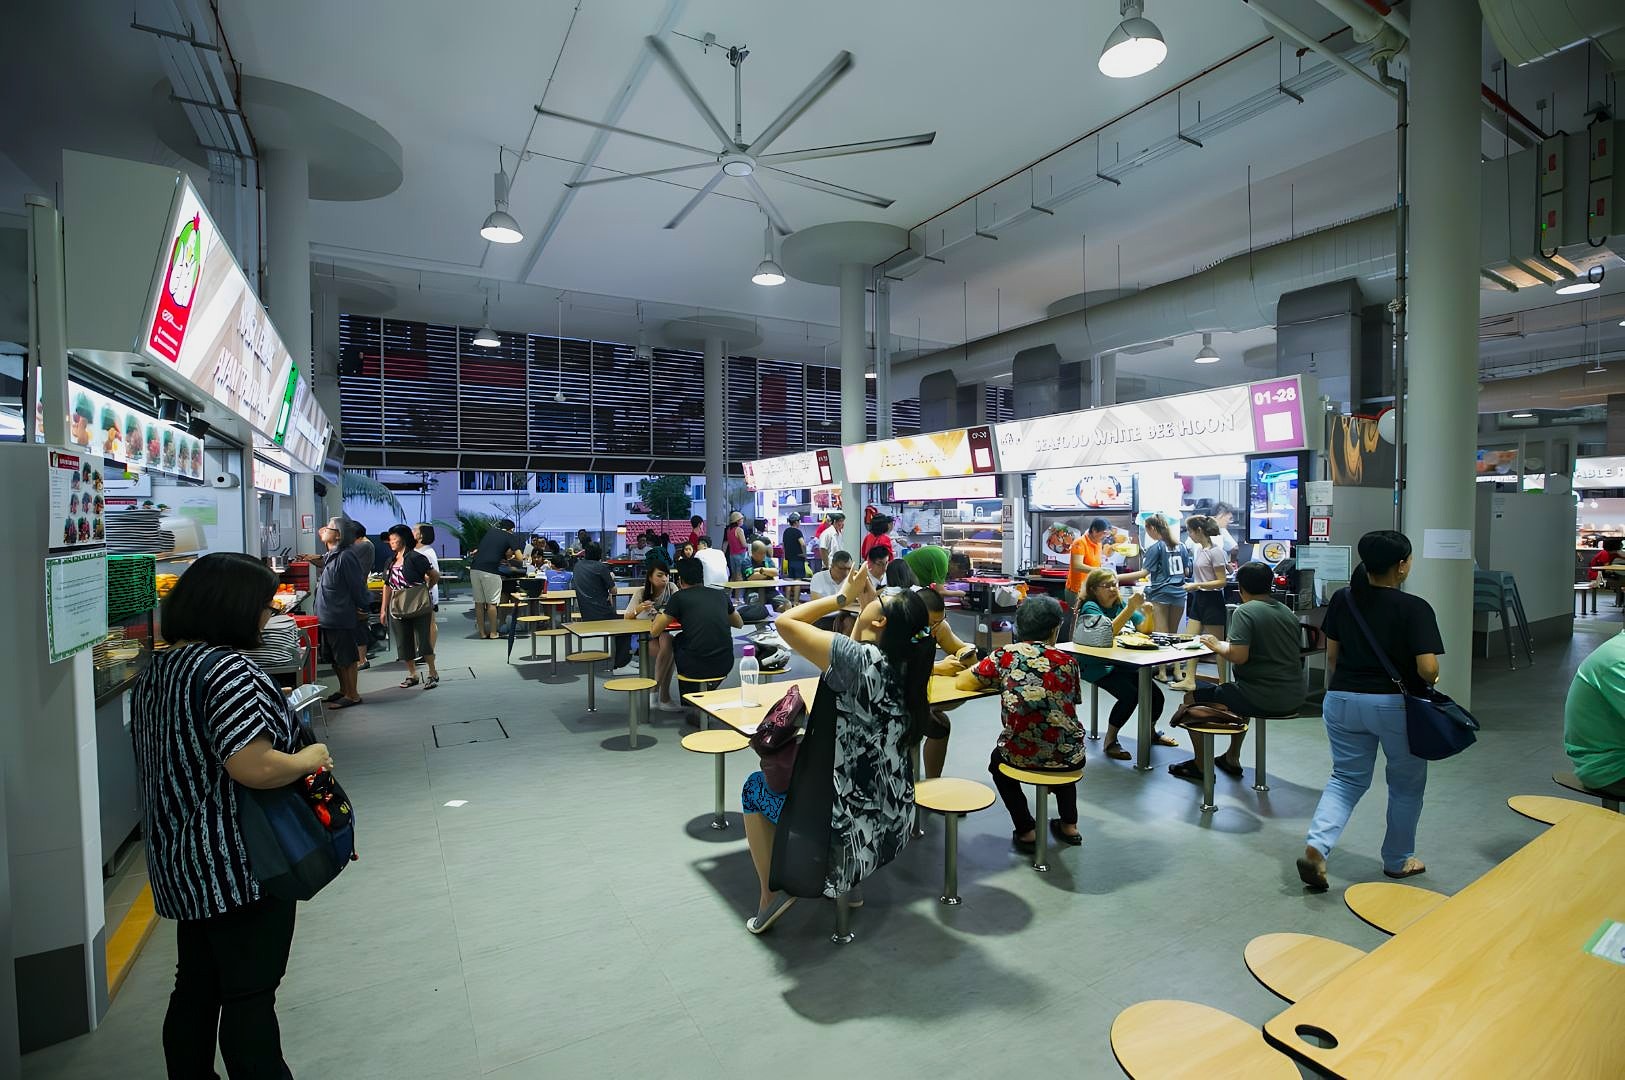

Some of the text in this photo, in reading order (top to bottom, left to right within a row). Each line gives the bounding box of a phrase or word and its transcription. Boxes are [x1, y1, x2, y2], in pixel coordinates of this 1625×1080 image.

[1254, 387, 1296, 405] 01-28
[1094, 424, 1143, 446] WHITE
[1178, 413, 1236, 437] HOON
[1168, 553, 1185, 576] 10
